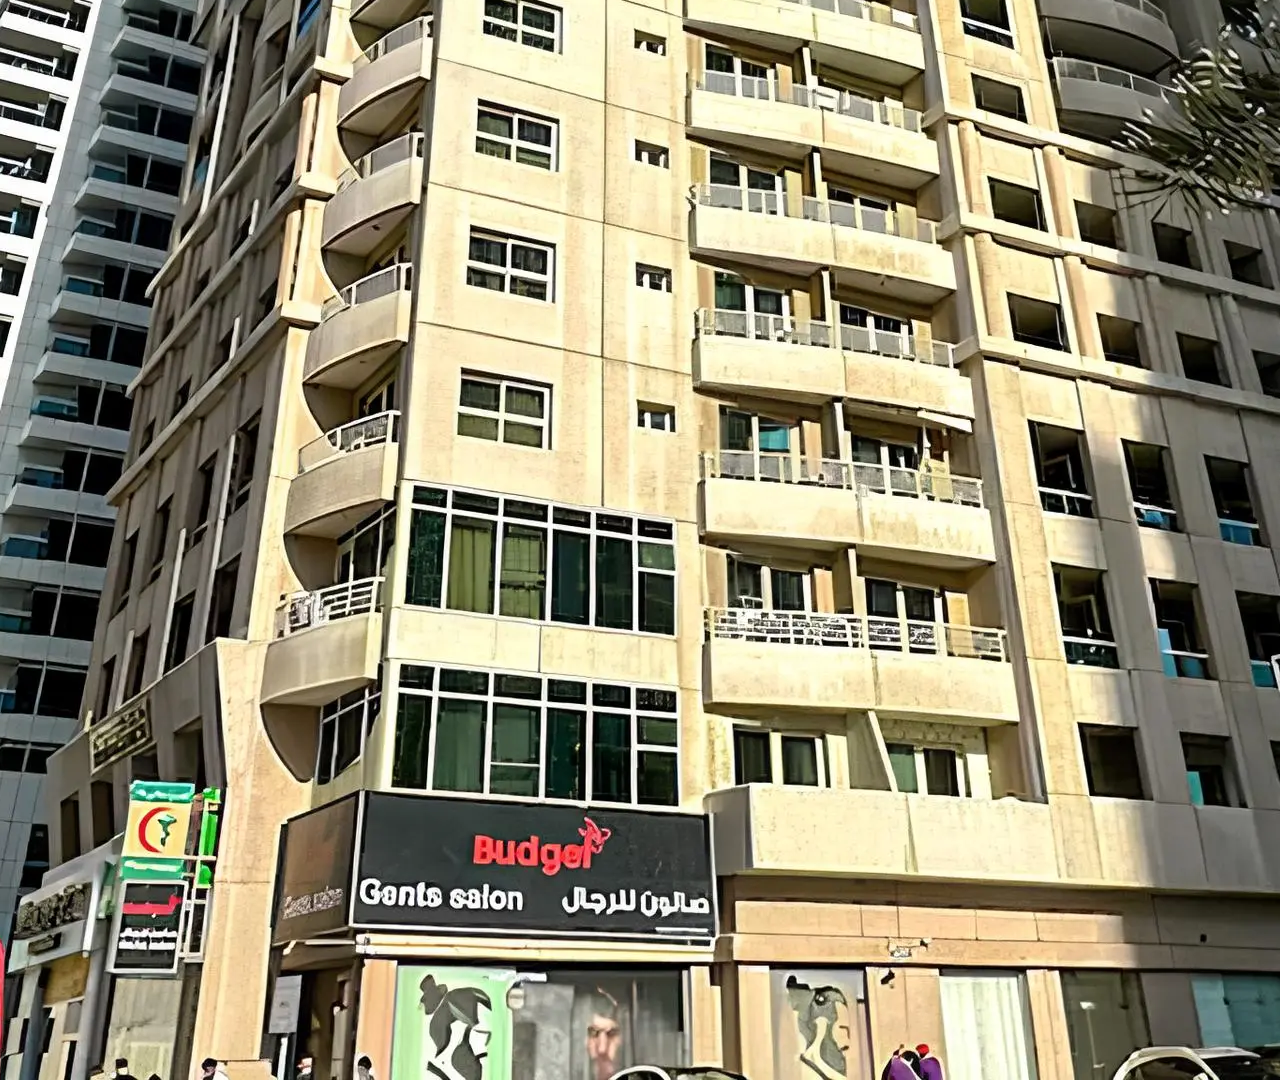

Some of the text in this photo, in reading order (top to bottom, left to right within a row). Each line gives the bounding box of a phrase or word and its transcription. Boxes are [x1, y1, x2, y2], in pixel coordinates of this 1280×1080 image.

[473, 824, 596, 875] Budget
[359, 877, 442, 908] Gents
[449, 883, 524, 911] salon
[561, 886, 710, 918] صالون للرجال
